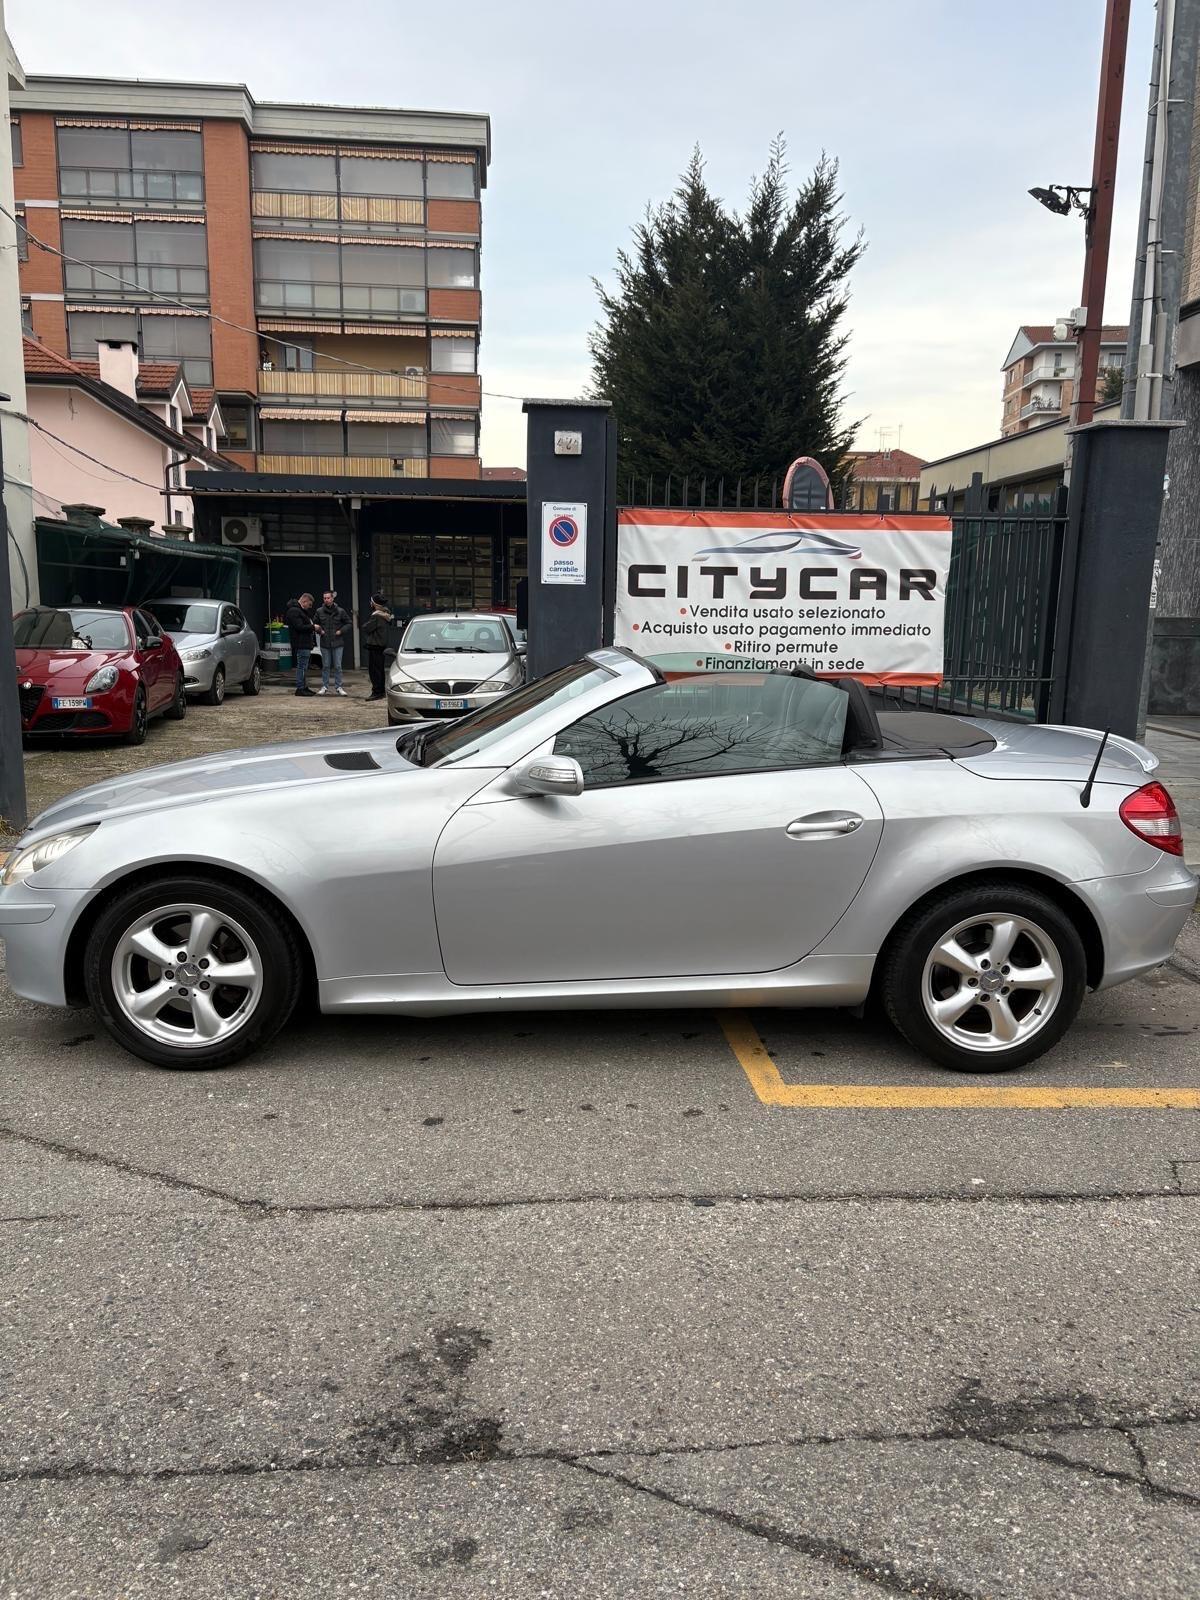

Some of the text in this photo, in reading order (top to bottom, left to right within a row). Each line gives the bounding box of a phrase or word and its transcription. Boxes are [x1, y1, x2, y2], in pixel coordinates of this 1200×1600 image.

[628, 564, 937, 601] CITYCAR
[690, 605, 886, 619] Vendita usato selezionato
[641, 621, 931, 638] Acquisto usato pagamento immediato
[734, 640, 838, 655] Ritiro permute
[812, 658, 824, 669] in
[828, 658, 865, 670] sede
